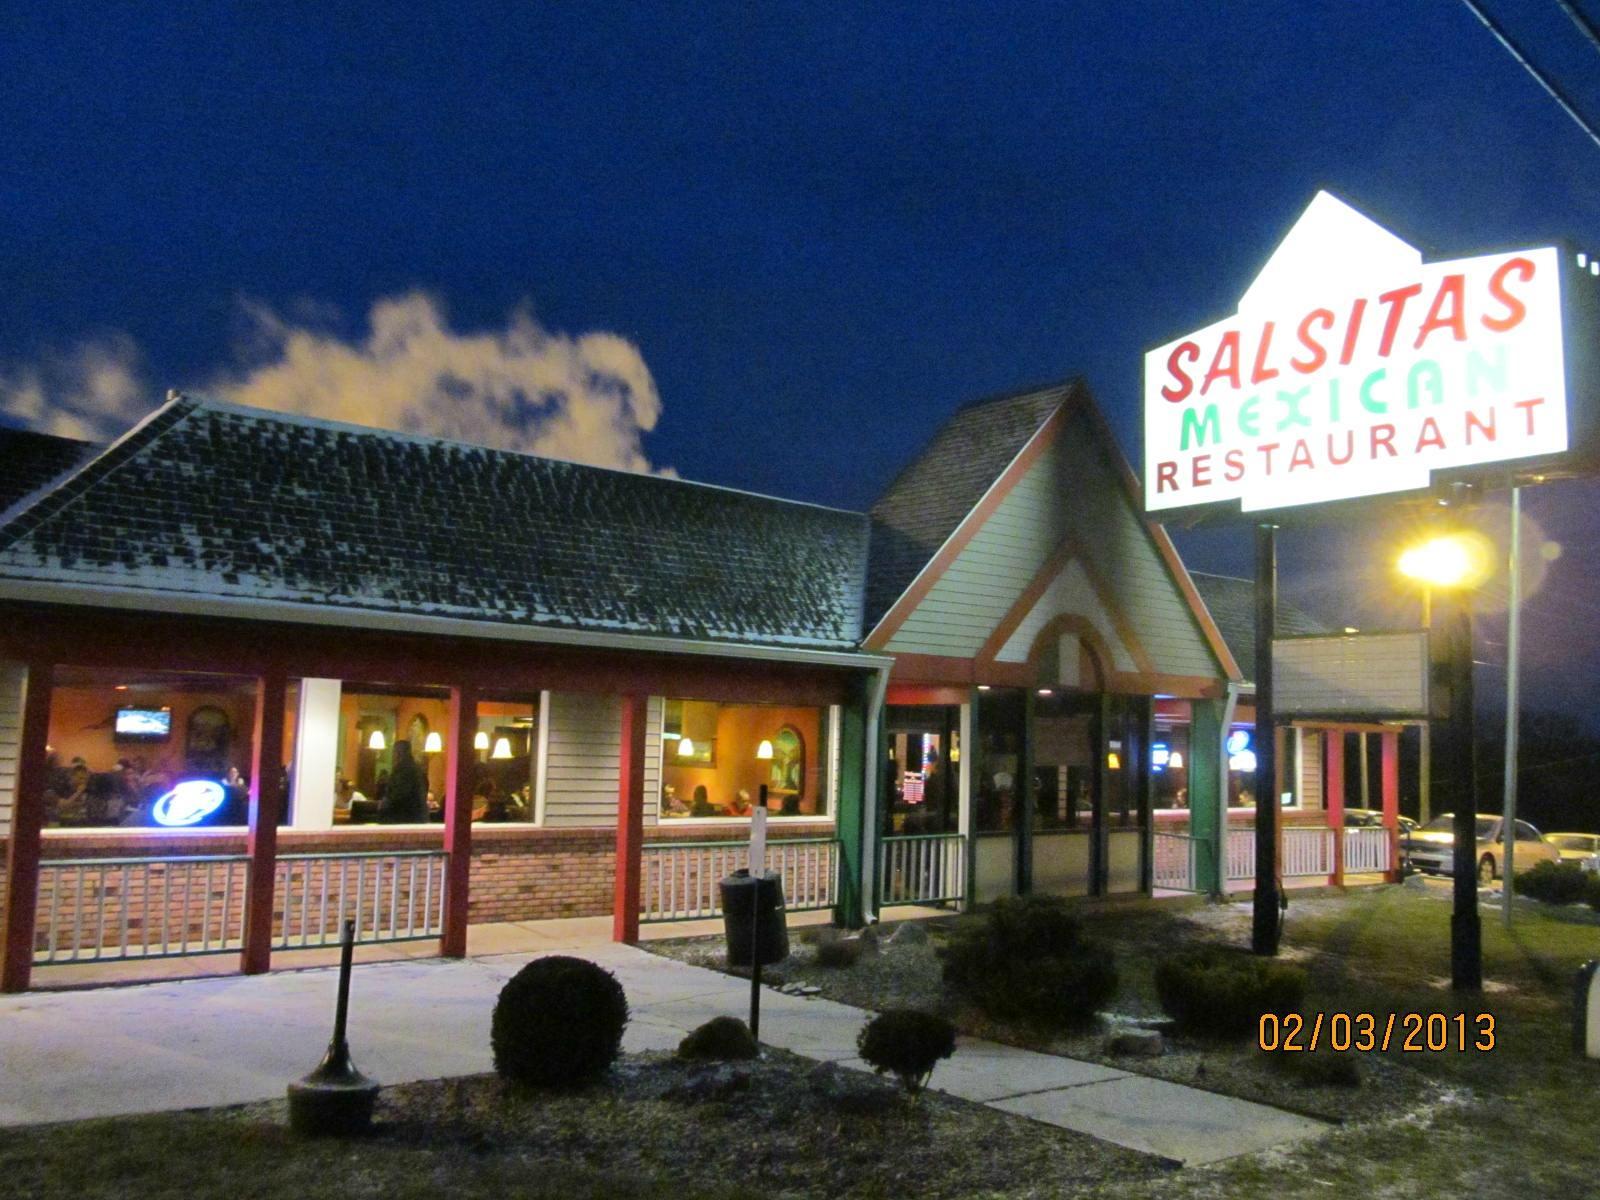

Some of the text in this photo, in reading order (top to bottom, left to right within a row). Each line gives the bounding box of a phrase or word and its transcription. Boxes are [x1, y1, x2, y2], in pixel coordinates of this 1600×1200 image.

[1161, 257, 1535, 402] SALSITAS
[1156, 397, 1544, 493] RESTAURANT
[1180, 344, 1512, 450] MEXICAN
